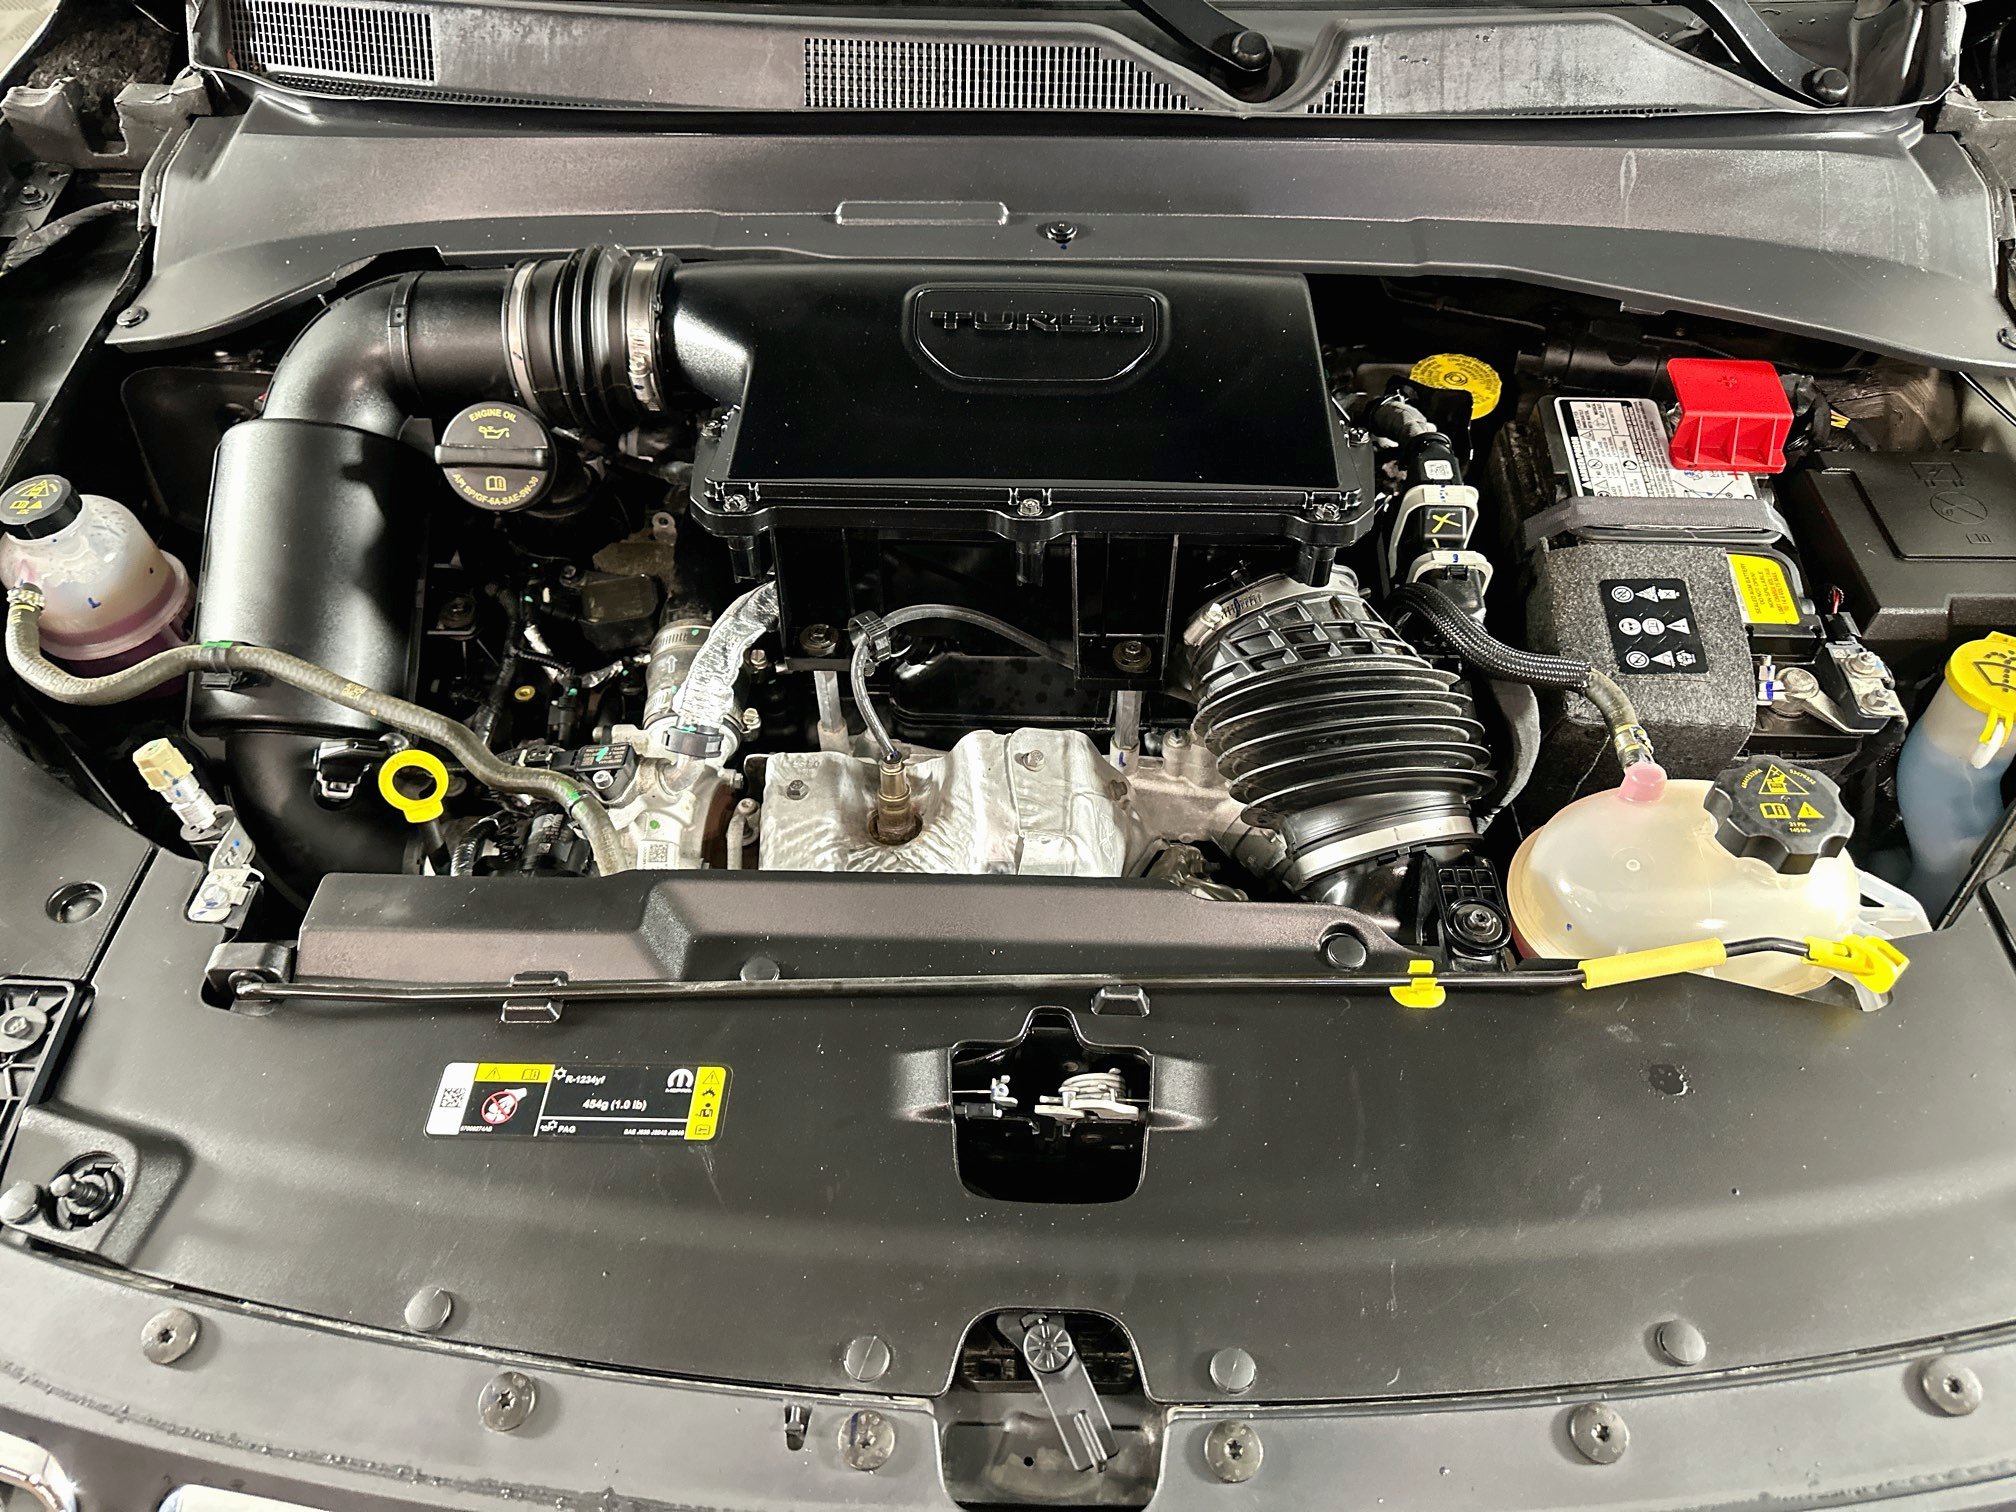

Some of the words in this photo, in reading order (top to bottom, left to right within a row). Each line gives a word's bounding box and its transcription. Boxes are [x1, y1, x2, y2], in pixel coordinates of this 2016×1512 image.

[930, 310, 1144, 333] TURBO
[469, 408, 502, 422] ENGINE
[503, 410, 517, 423] OIL
[452, 473, 464, 489] API
[1740, 563, 1751, 583] BATTERY
[1751, 595, 1761, 614] SEALED
[564, 1074, 606, 1086] R-1234yf
[582, 1099, 609, 1111] 454g
[610, 1099, 631, 1111] (1.0
[632, 1099, 647, 1112] lb)
[557, 1125, 576, 1134] PAG
